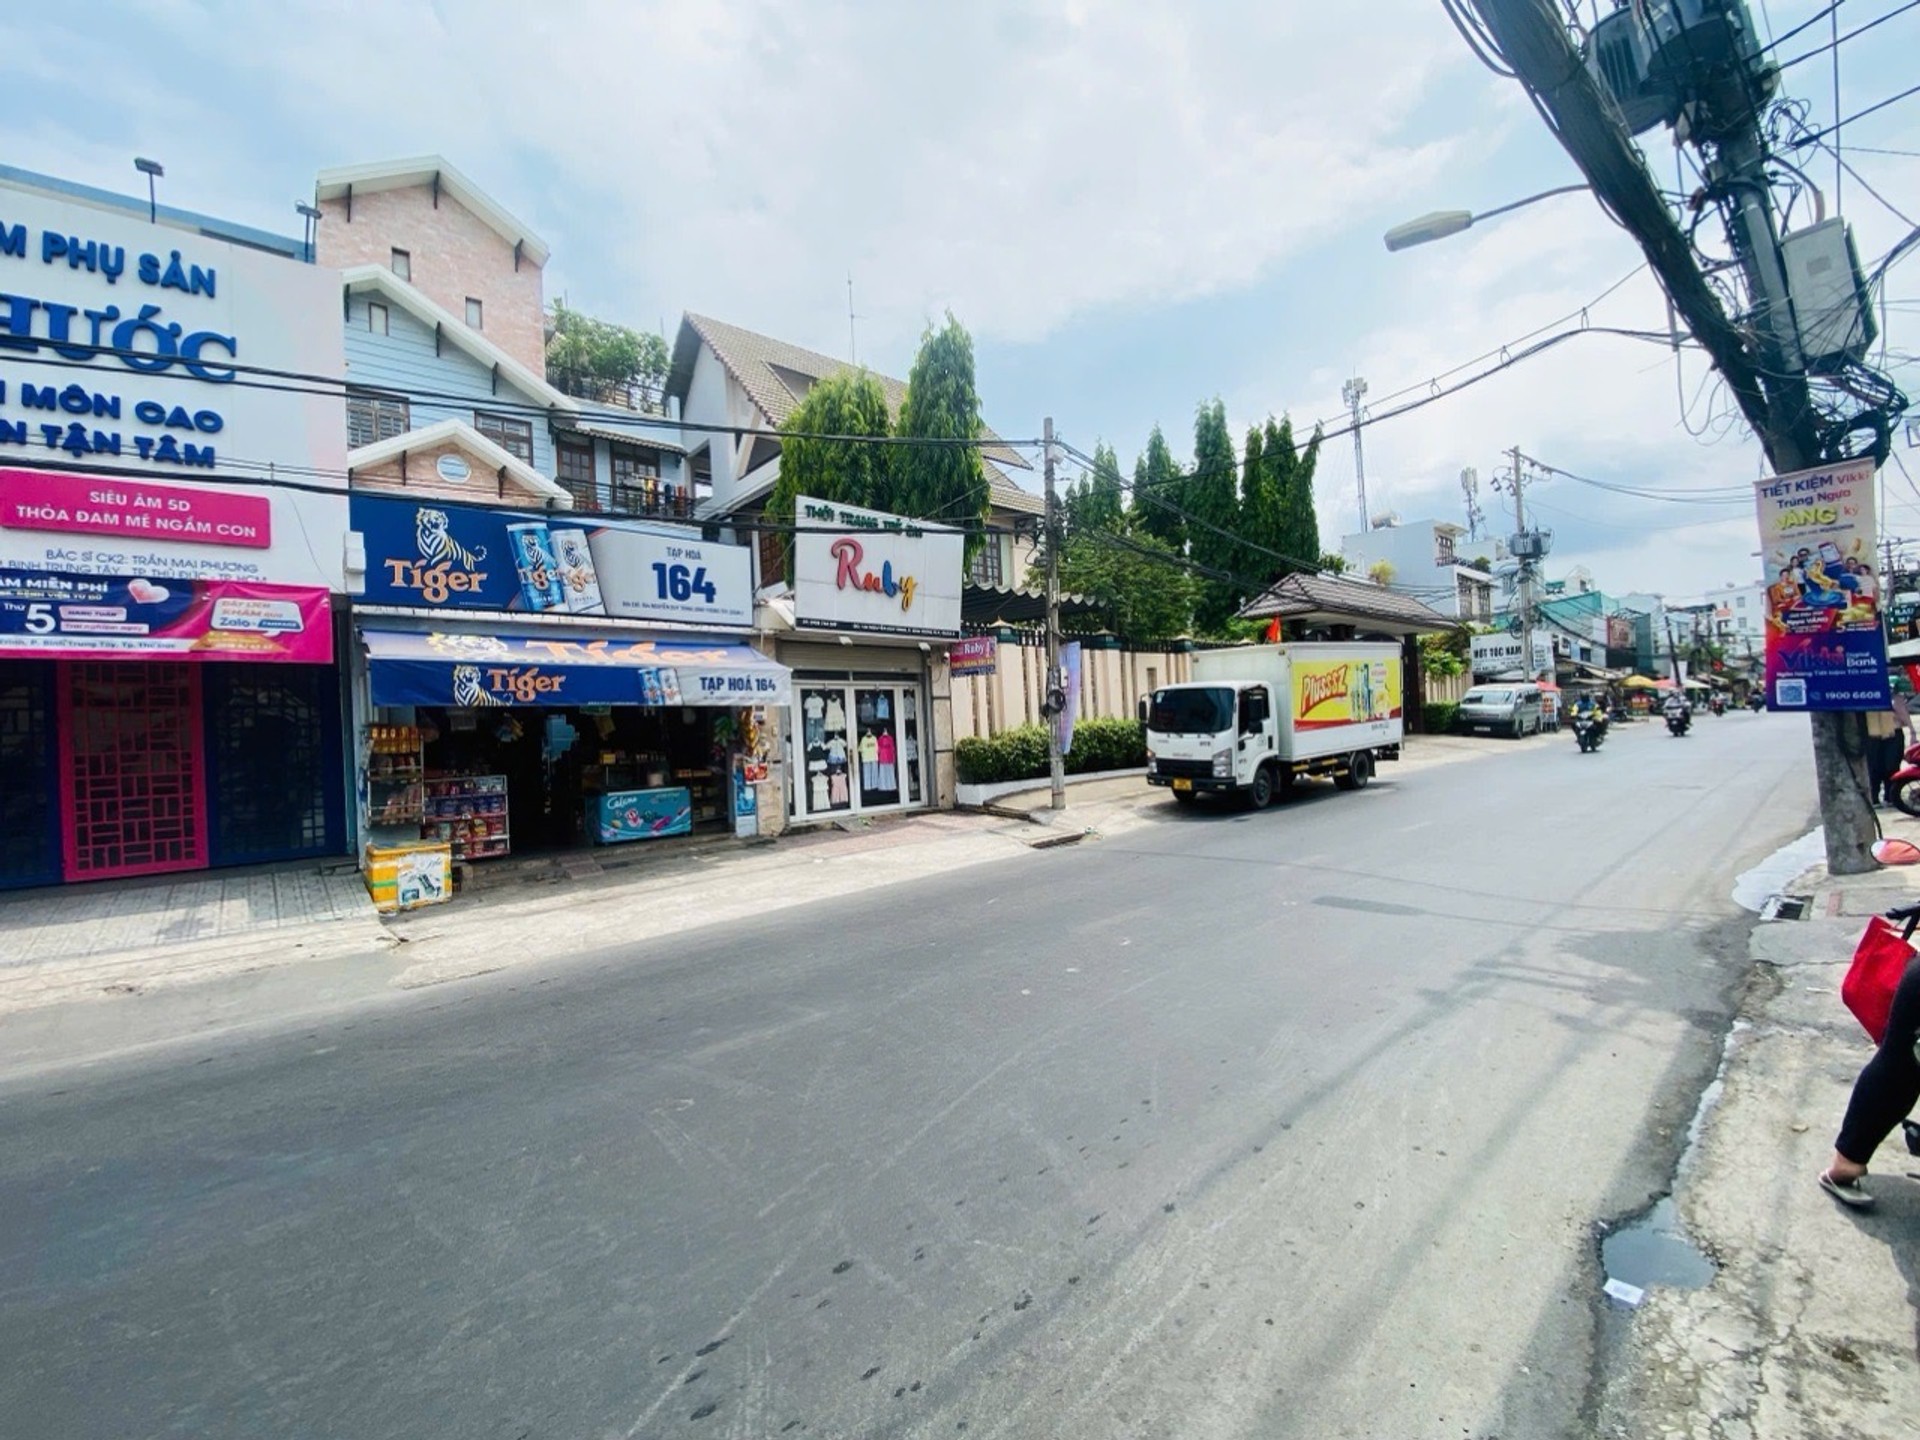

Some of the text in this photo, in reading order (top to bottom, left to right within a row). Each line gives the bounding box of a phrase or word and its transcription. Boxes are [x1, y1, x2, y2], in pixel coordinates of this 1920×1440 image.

[42, 230, 124, 284] PHỤ
[138, 250, 215, 298] SẢN
[22, 384, 120, 419] MÔN
[135, 401, 223, 433] CAO
[41, 422, 120, 457] TẬN
[134, 435, 215, 468] TÂM
[1761, 472, 1869, 498] TIẾT KIỆM Vikki
[90, 491, 191, 512] SIÊU ÂM 5D
[1777, 496, 1813, 508] Trúng
[17, 504, 69, 522] THỎA
[76, 510, 120, 526] ĐAM
[156, 516, 211, 534] NGẮM
[217, 524, 256, 538] CON
[839, 511, 879, 529] TRANG
[1775, 507, 1837, 530] VÀNG
[46, 548, 258, 574] BÁC SĨ CK2: TRẦN MAI PHƯƠNG
[666, 547, 683, 560] TẠP
[27, 577, 73, 589] MIỄN
[77, 582, 108, 593] PHÍ
[385, 559, 488, 603] Tiger
[652, 562, 716, 604] 164
[831, 537, 918, 612] Ruby
[25, 603, 56, 634] 5
[220, 617, 249, 628] Zalo
[964, 643, 985, 655] Ruby
[1847, 657, 1878, 667] Bank
[486, 666, 776, 702] Tiger TẠP HOÁ 164
[1825, 691, 1881, 700] 1900 6608
